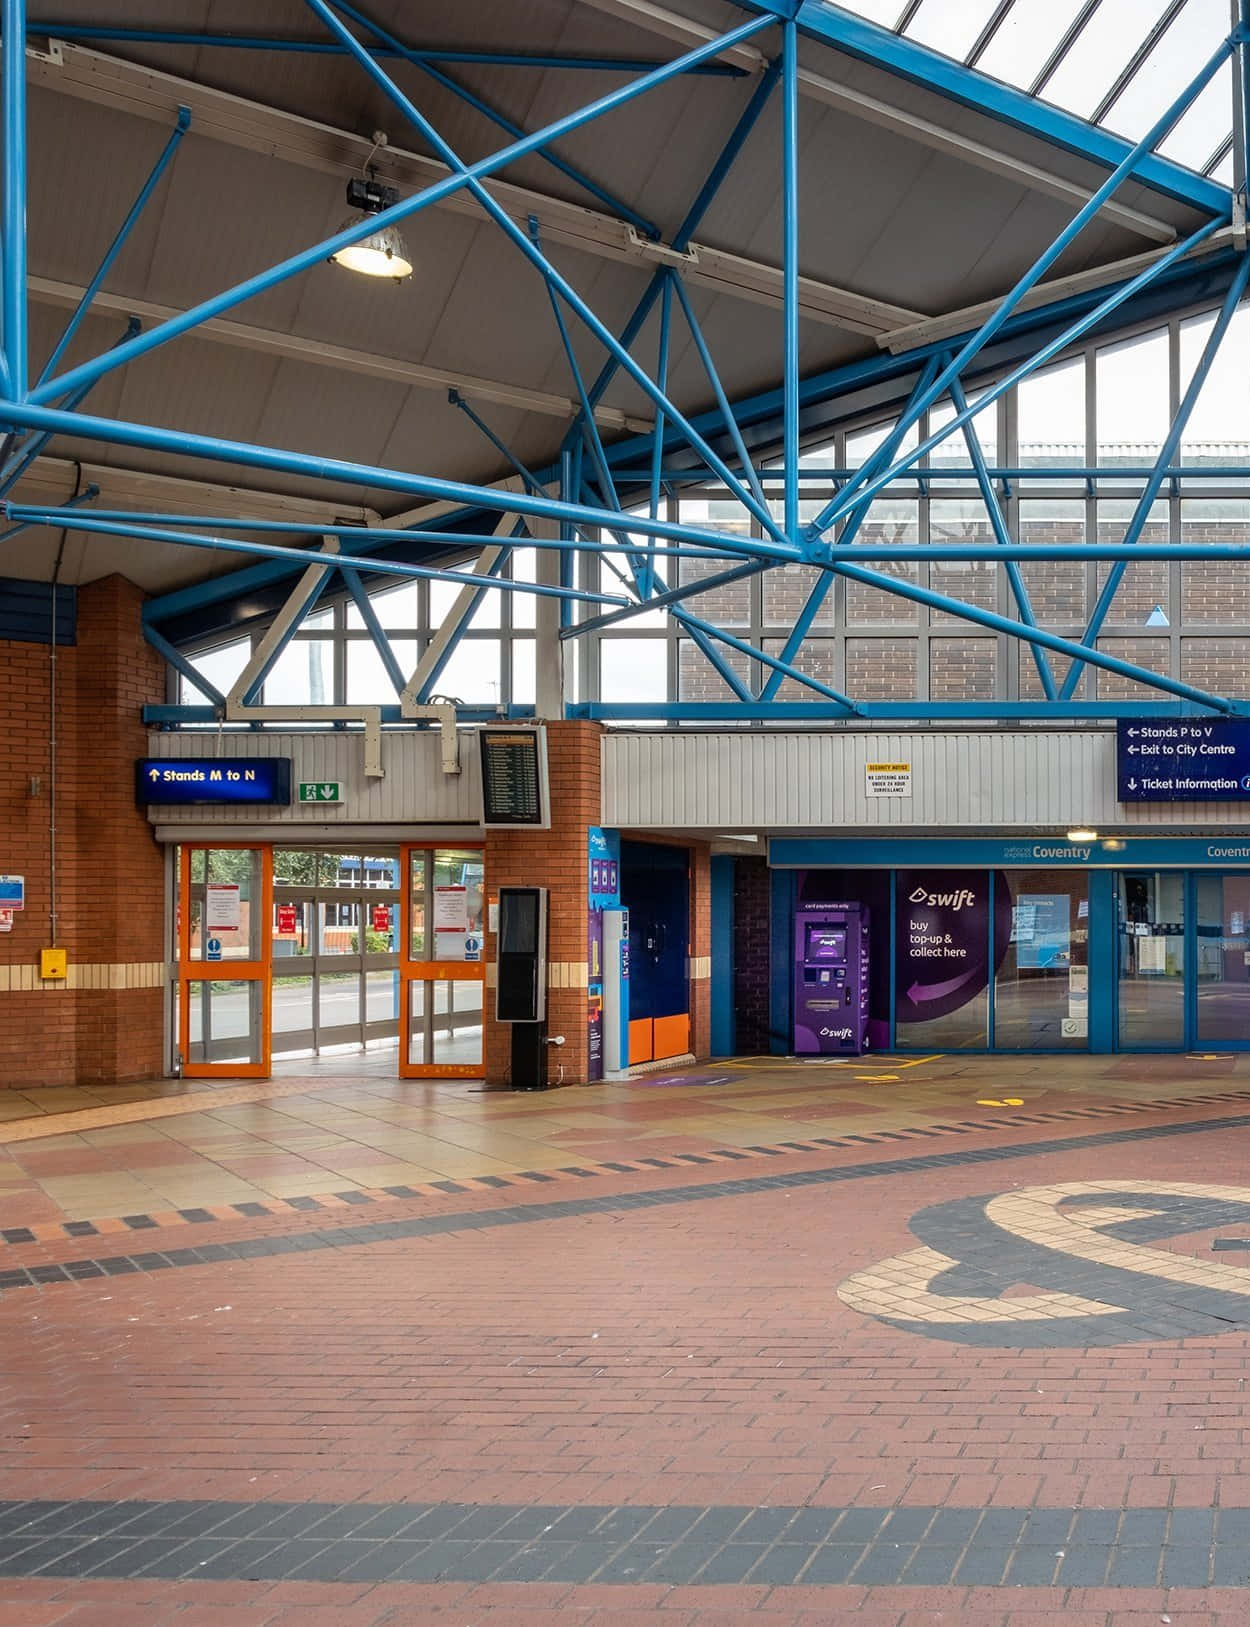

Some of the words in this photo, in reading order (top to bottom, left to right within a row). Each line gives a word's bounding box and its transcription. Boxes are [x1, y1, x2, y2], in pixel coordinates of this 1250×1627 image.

[1141, 727, 1178, 738] Stands
[1180, 728, 1188, 737] P
[1190, 728, 1202, 738] to
[1204, 728, 1213, 737] V
[1140, 744, 1160, 754] Exit
[1162, 744, 1174, 754] to
[1176, 744, 1198, 757] City
[1200, 744, 1236, 754] Centre
[163, 769, 206, 782] Stands
[210, 770, 222, 782] M
[226, 770, 240, 782] to
[244, 770, 255, 780] N
[1142, 778, 1173, 788] Ticket
[1176, 778, 1238, 789] Information
[1033, 846, 1091, 860] Coventry
[927, 890, 976, 911] swift
[910, 920, 928, 932] buy
[910, 934, 943, 945] top-up
[944, 934, 952, 944] &
[910, 946, 942, 957] collect
[944, 946, 967, 957] here
[830, 1028, 852, 1039] swift
